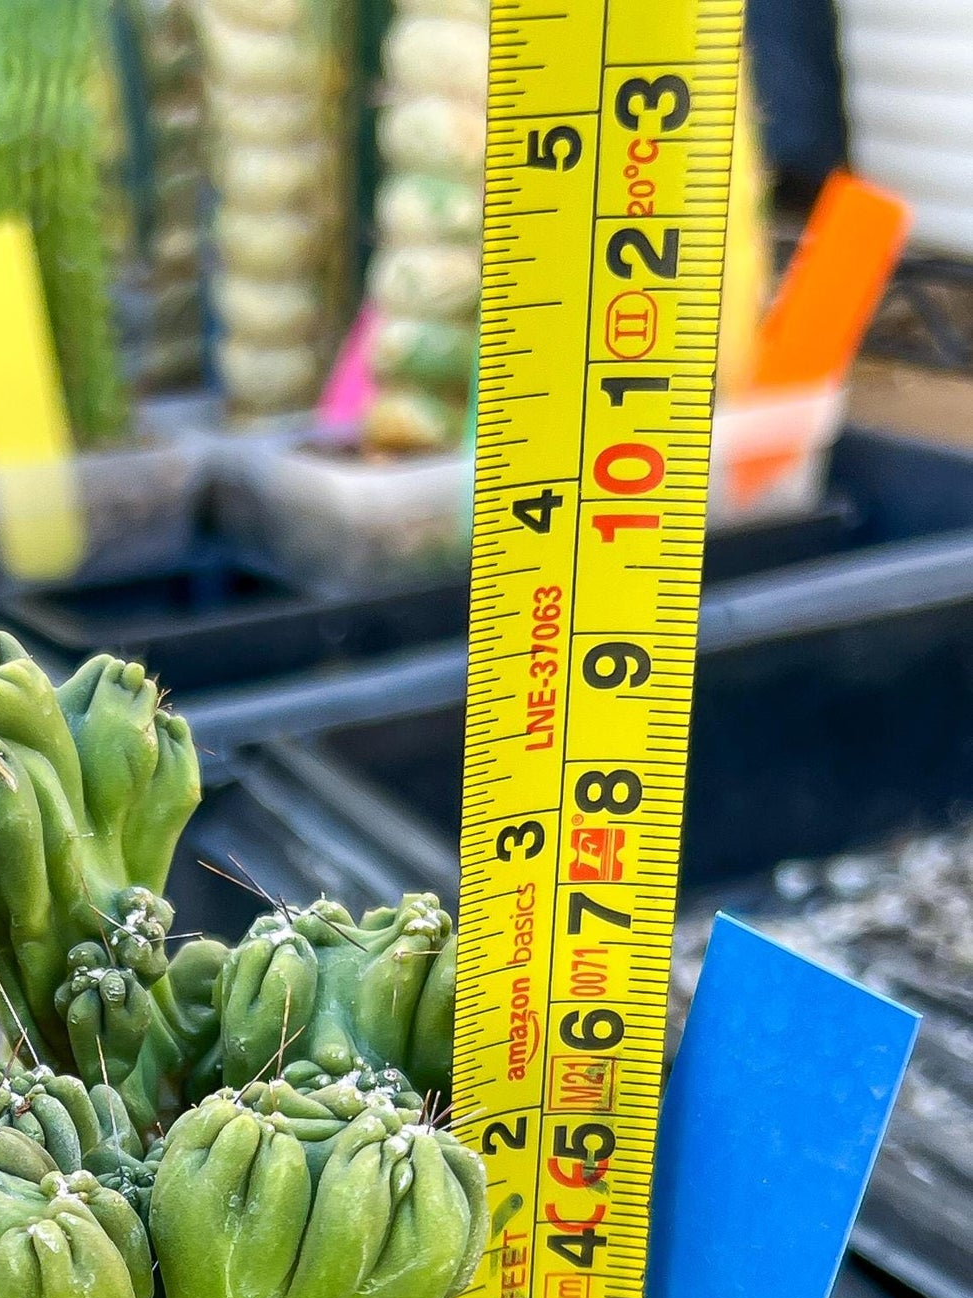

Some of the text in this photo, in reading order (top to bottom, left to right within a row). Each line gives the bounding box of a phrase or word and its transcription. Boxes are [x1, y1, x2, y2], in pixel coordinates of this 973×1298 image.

[615, 74, 692, 132] 3
[526, 125, 582, 172] 5
[606, 228, 680, 280] 2
[600, 377, 670, 406] 1
[512, 488, 564, 534] 4
[592, 442, 666, 543] 10
[525, 585, 562, 751] LNE-37063
[583, 642, 652, 690] 9
[575, 769, 644, 815] 8
[496, 821, 544, 861] 3
[569, 892, 632, 935] 7
[507, 882, 536, 1081] amazon basics
[570, 948, 609, 996] 0071
[560, 1008, 625, 1051] 6
[482, 1116, 528, 1155] 2
[553, 1123, 616, 1161] 5
[547, 1228, 607, 1268] 4
